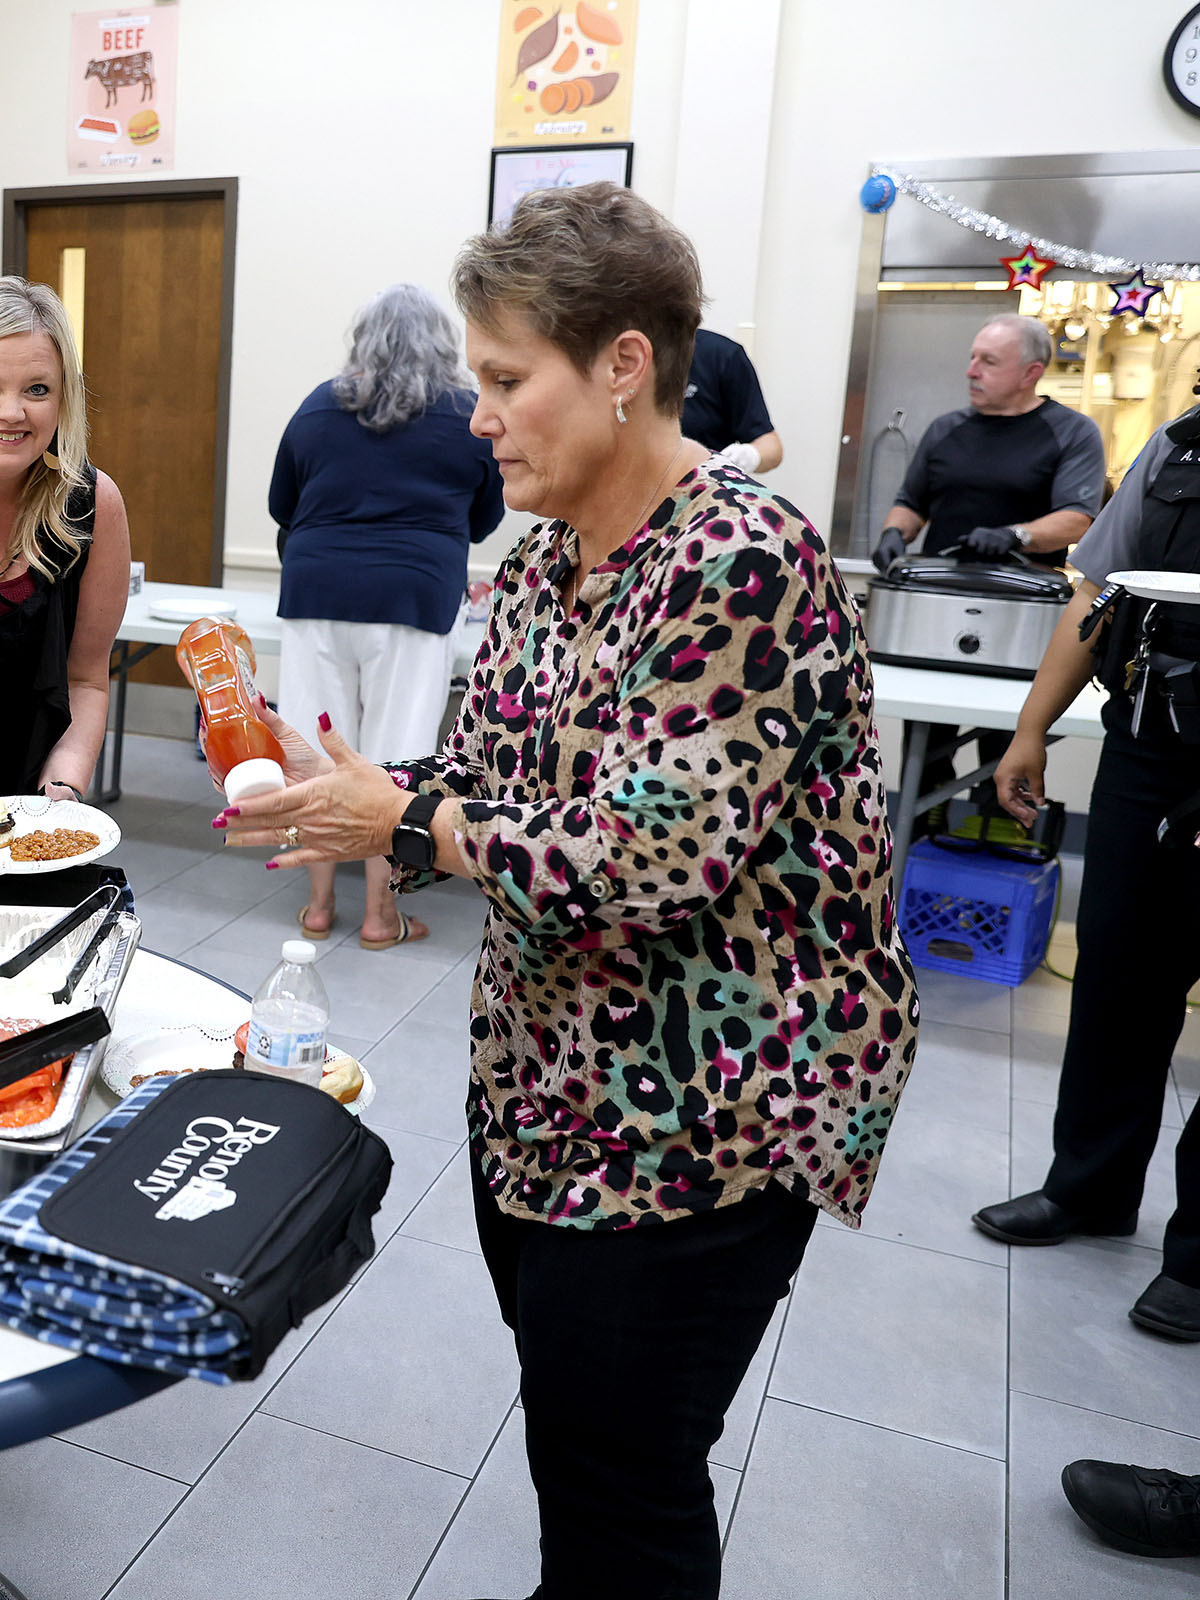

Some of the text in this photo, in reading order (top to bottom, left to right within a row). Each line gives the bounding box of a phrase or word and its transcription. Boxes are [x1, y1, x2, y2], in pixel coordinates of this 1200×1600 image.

[103, 28, 145, 51] BEEF
[1185, 48, 1198, 64] 9
[1186, 71, 1197, 87] 8
[133, 1116, 234, 1202] County
[198, 1116, 281, 1182] Reno
